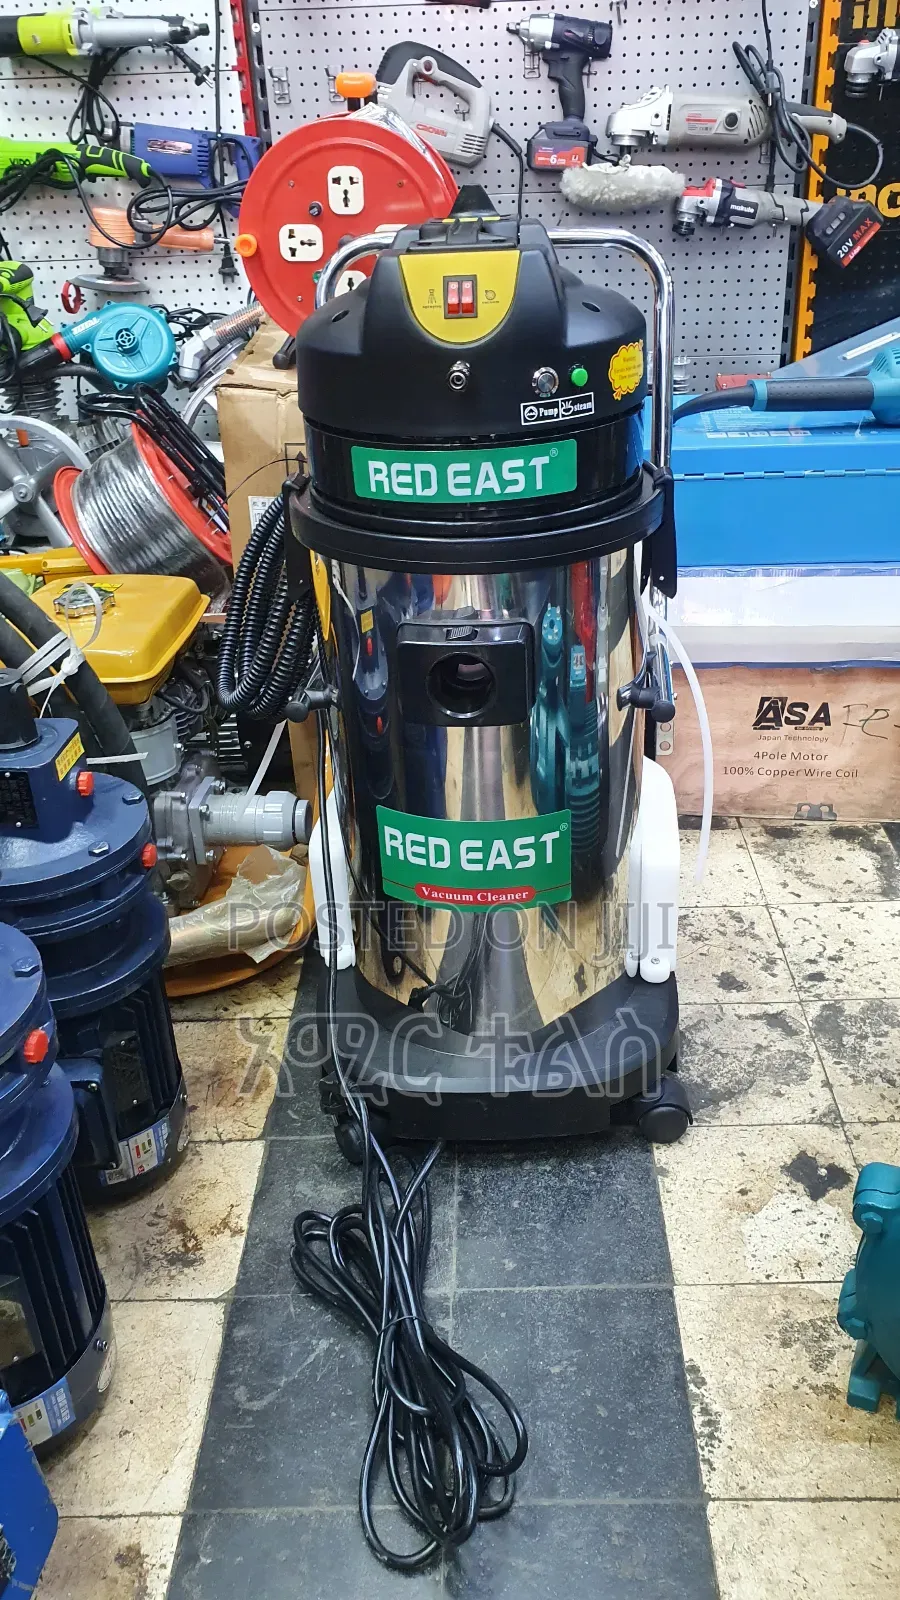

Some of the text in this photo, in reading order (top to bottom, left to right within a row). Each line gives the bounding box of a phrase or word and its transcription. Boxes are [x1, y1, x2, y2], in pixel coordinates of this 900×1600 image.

[415, 123, 448, 138] CROWN
[549, 154, 558, 165] 6
[836, 216, 874, 259] 20V MAX
[539, 401, 592, 418] Pump steam
[367, 455, 550, 497] RED EAST
[758, 734, 829, 744] Japan Technology
[753, 751, 829, 761] 4Pole Motor
[723, 766, 859, 778] 100% Copper Wire Coil
[384, 825, 560, 872] RED EAST
[421, 886, 529, 902] Vacuum Cleaner
